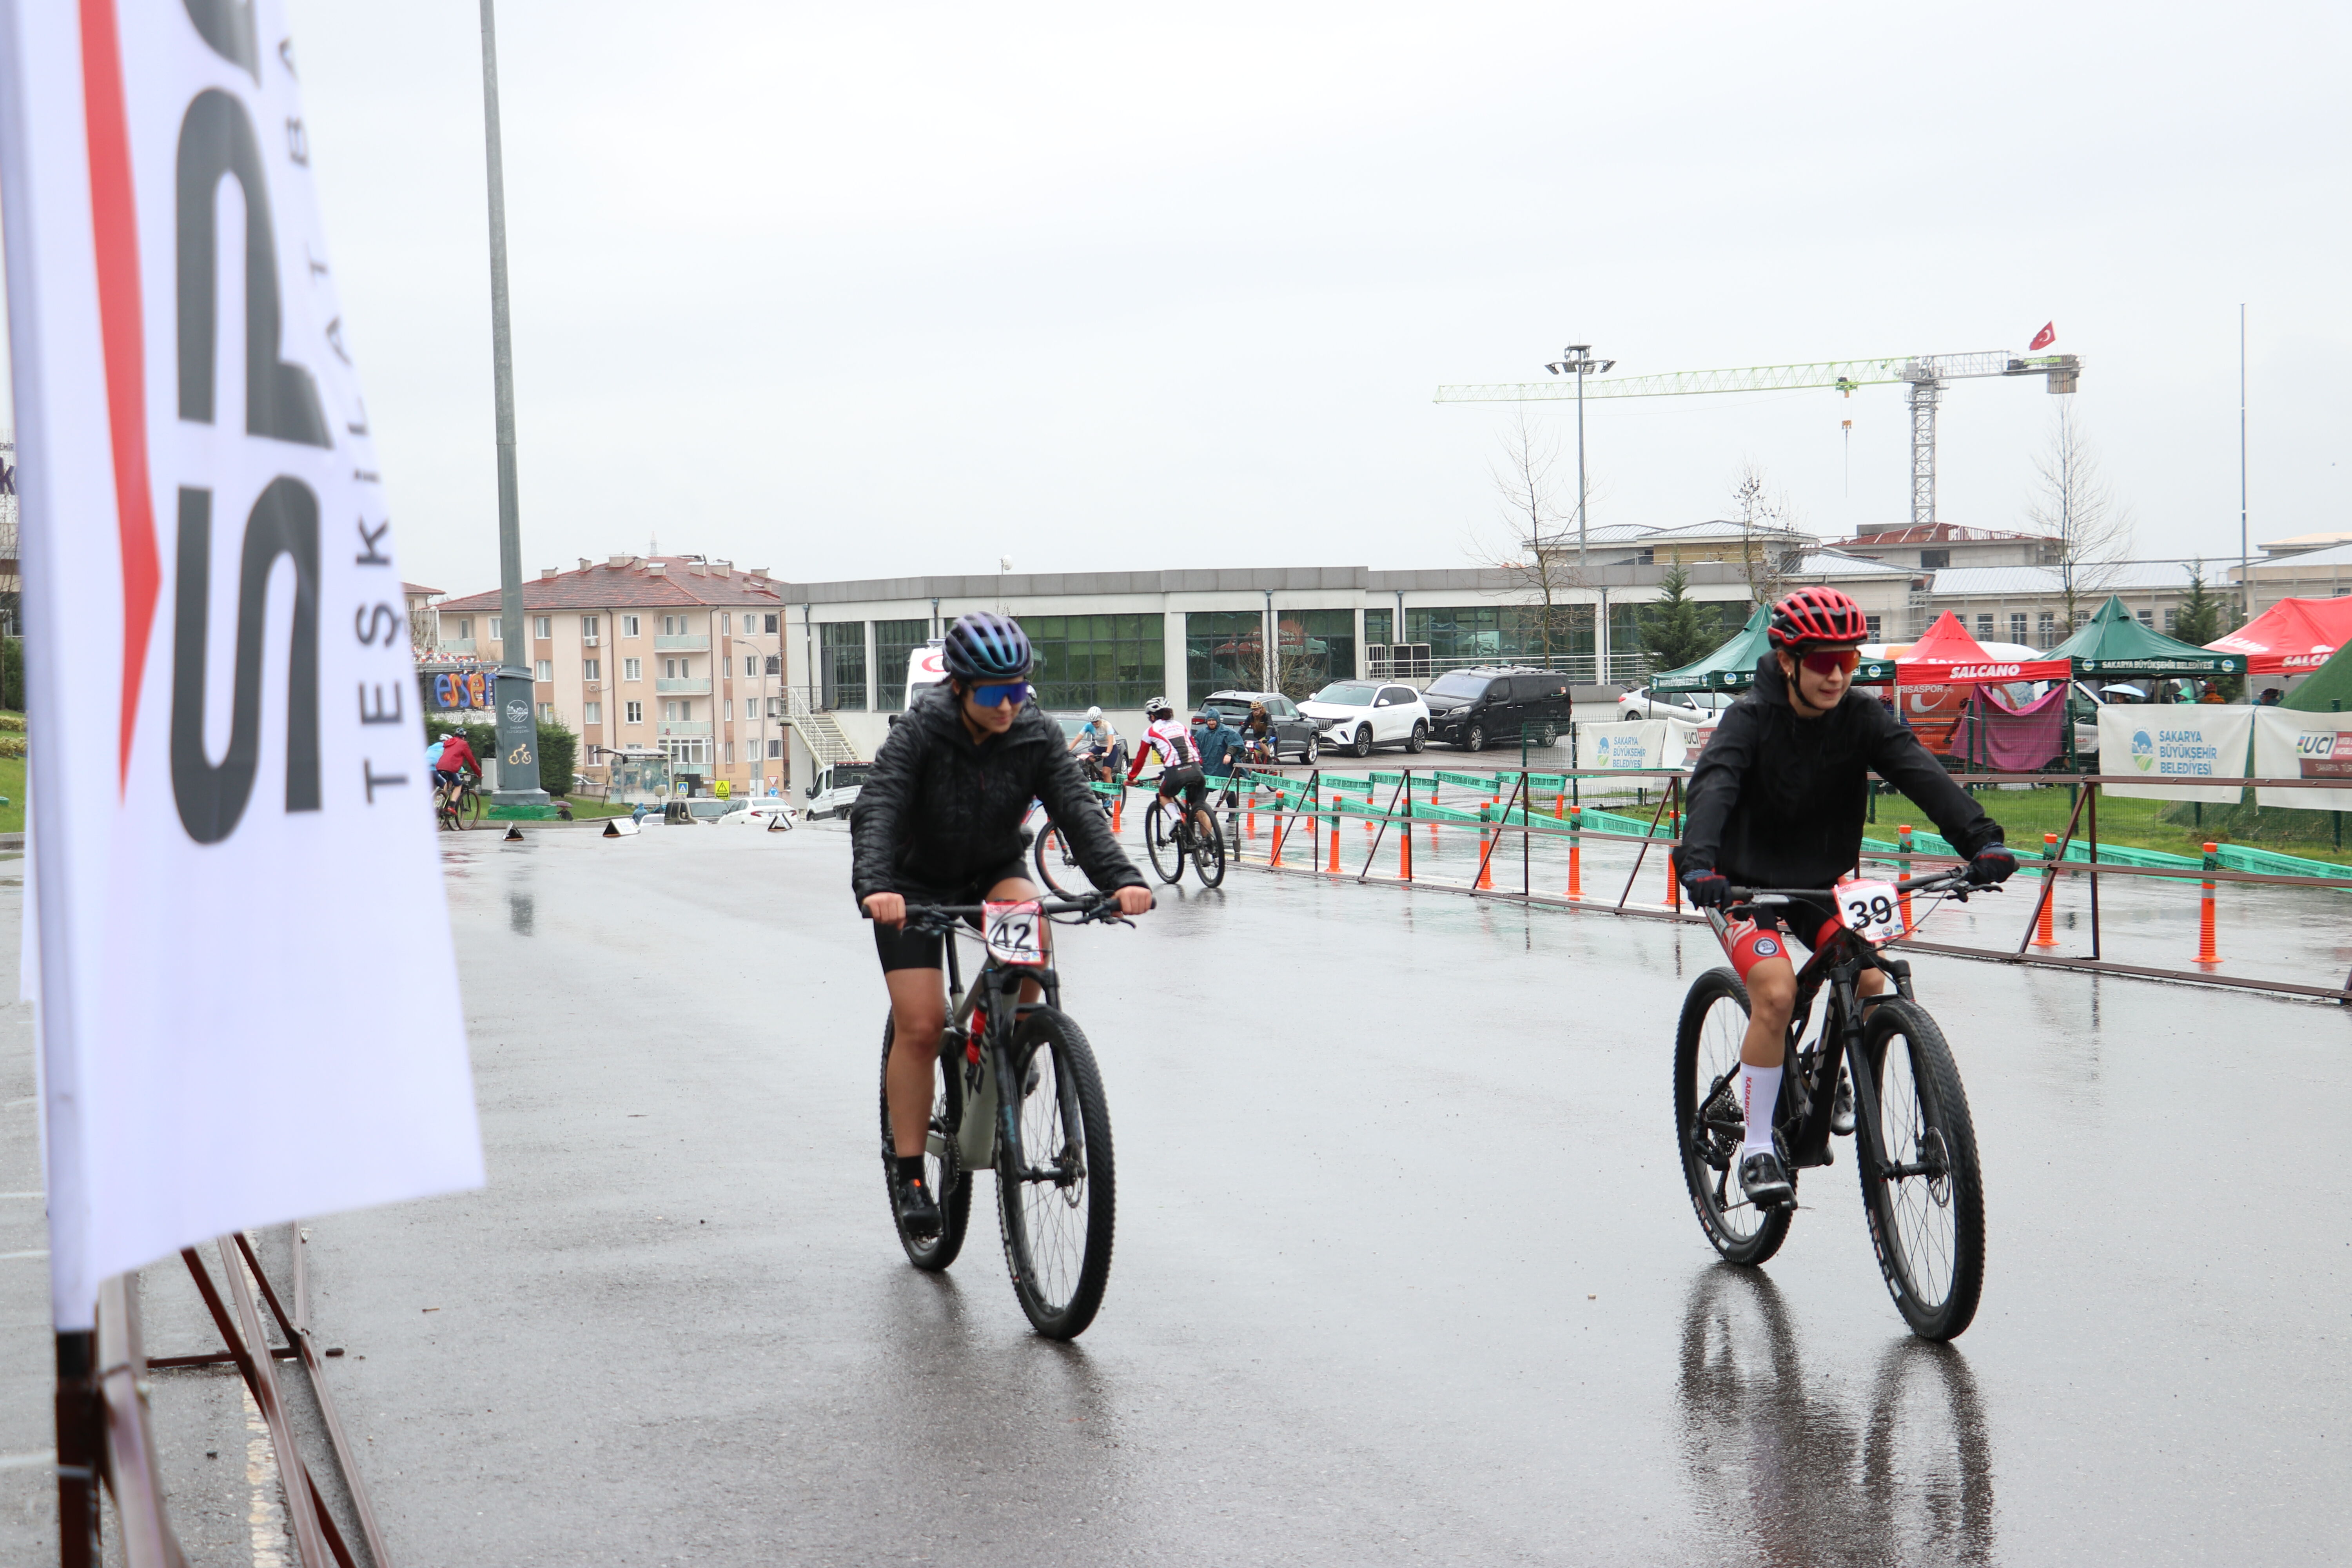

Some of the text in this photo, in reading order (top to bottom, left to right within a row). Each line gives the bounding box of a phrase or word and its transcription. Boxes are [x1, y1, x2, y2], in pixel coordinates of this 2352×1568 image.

[2134, 659, 2176, 670] BÜYÜKŞEHİR
[2176, 660, 2214, 669] BELEDİYESİ
[1949, 664, 2020, 679] SALCANO
[1900, 685, 1943, 693] RISASPOR
[1613, 736, 1638, 745] SAKARYA
[1686, 732, 1699, 744] UCI
[2159, 730, 2203, 742] SAKARYA
[2303, 737, 2334, 754] UCI
[1613, 746, 1646, 758] BÜYÜKŞEHİR
[2160, 744, 2217, 760] BÜYÜKŞEHİR
[1612, 758, 1642, 768] BELEDİYESİ
[2160, 760, 2212, 775] BELEDİYESİ
[1848, 895, 1892, 929] 39
[993, 922, 1032, 950] 42
